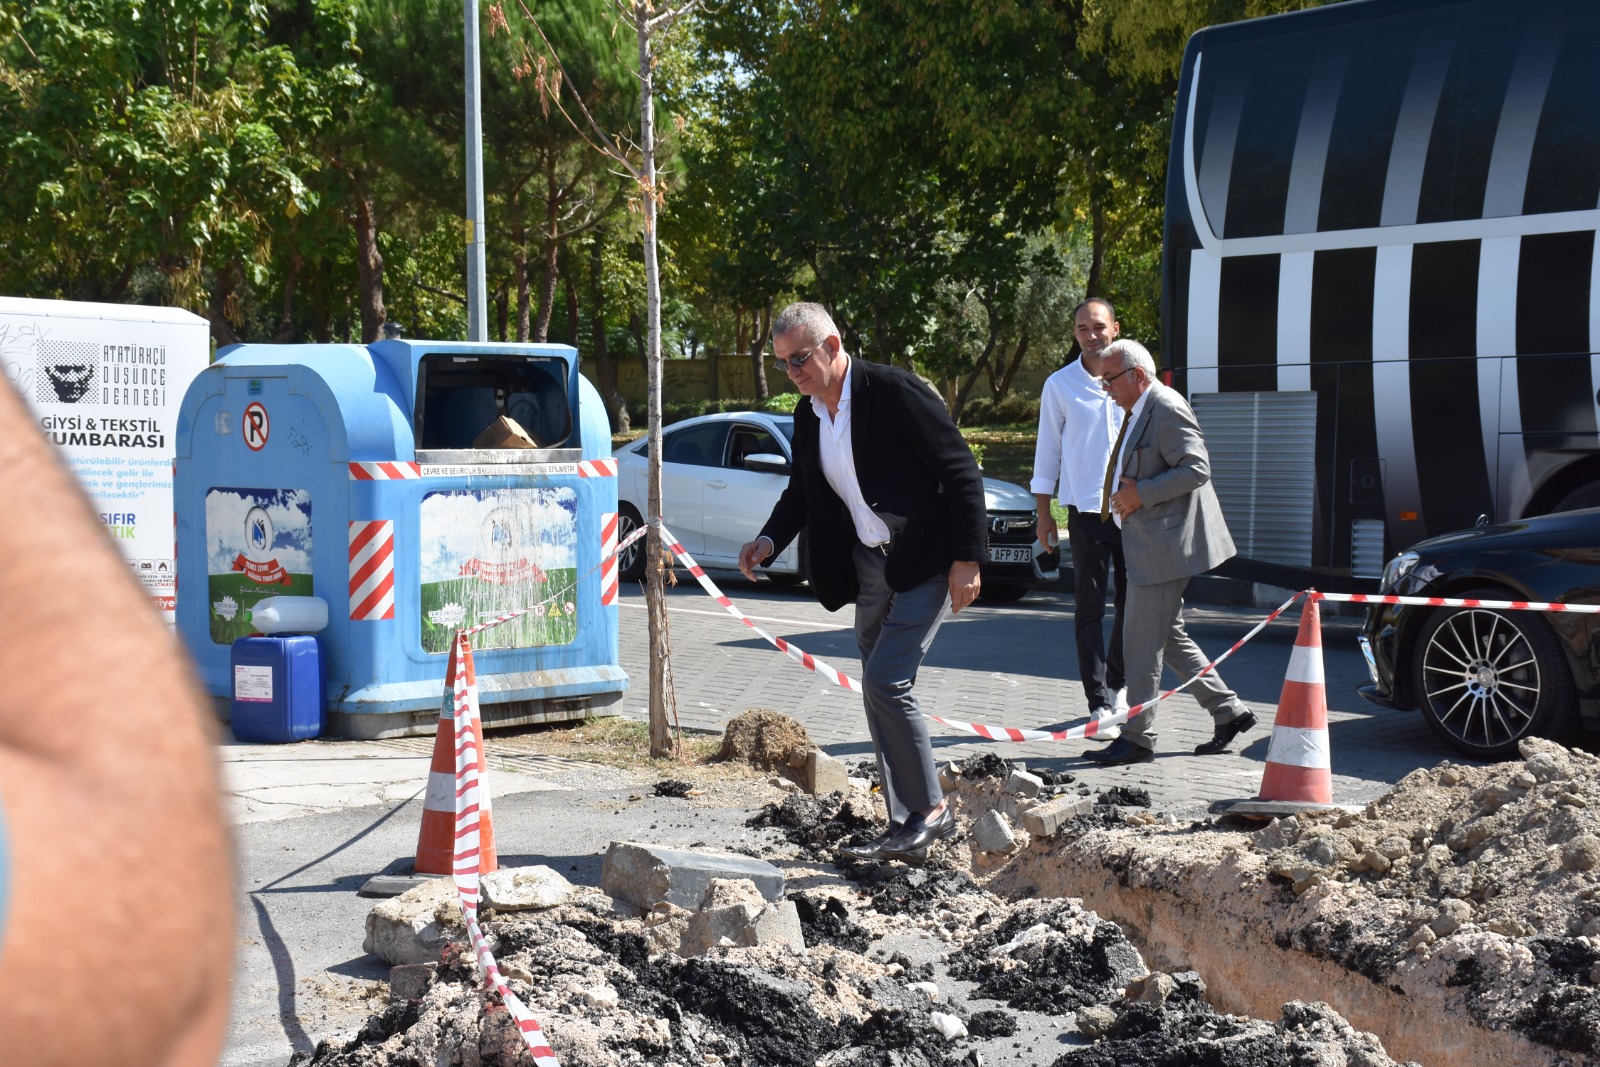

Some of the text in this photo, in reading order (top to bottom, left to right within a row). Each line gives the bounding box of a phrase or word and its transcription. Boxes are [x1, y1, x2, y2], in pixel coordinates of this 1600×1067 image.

[103, 343, 165, 366] ATATÜRKÇÜ
[103, 364, 165, 386] DÜŞÜNCE
[103, 387, 165, 407] DERNEĞİ
[41, 414, 160, 433] GİYSİ & TEKSTİL
[116, 468, 139, 478] gelir
[142, 468, 154, 477] ile
[100, 513, 136, 525] SIFIR
[110, 526, 136, 539] TIK
[995, 549, 1012, 561] AFP
[1013, 549, 1030, 561] 973
